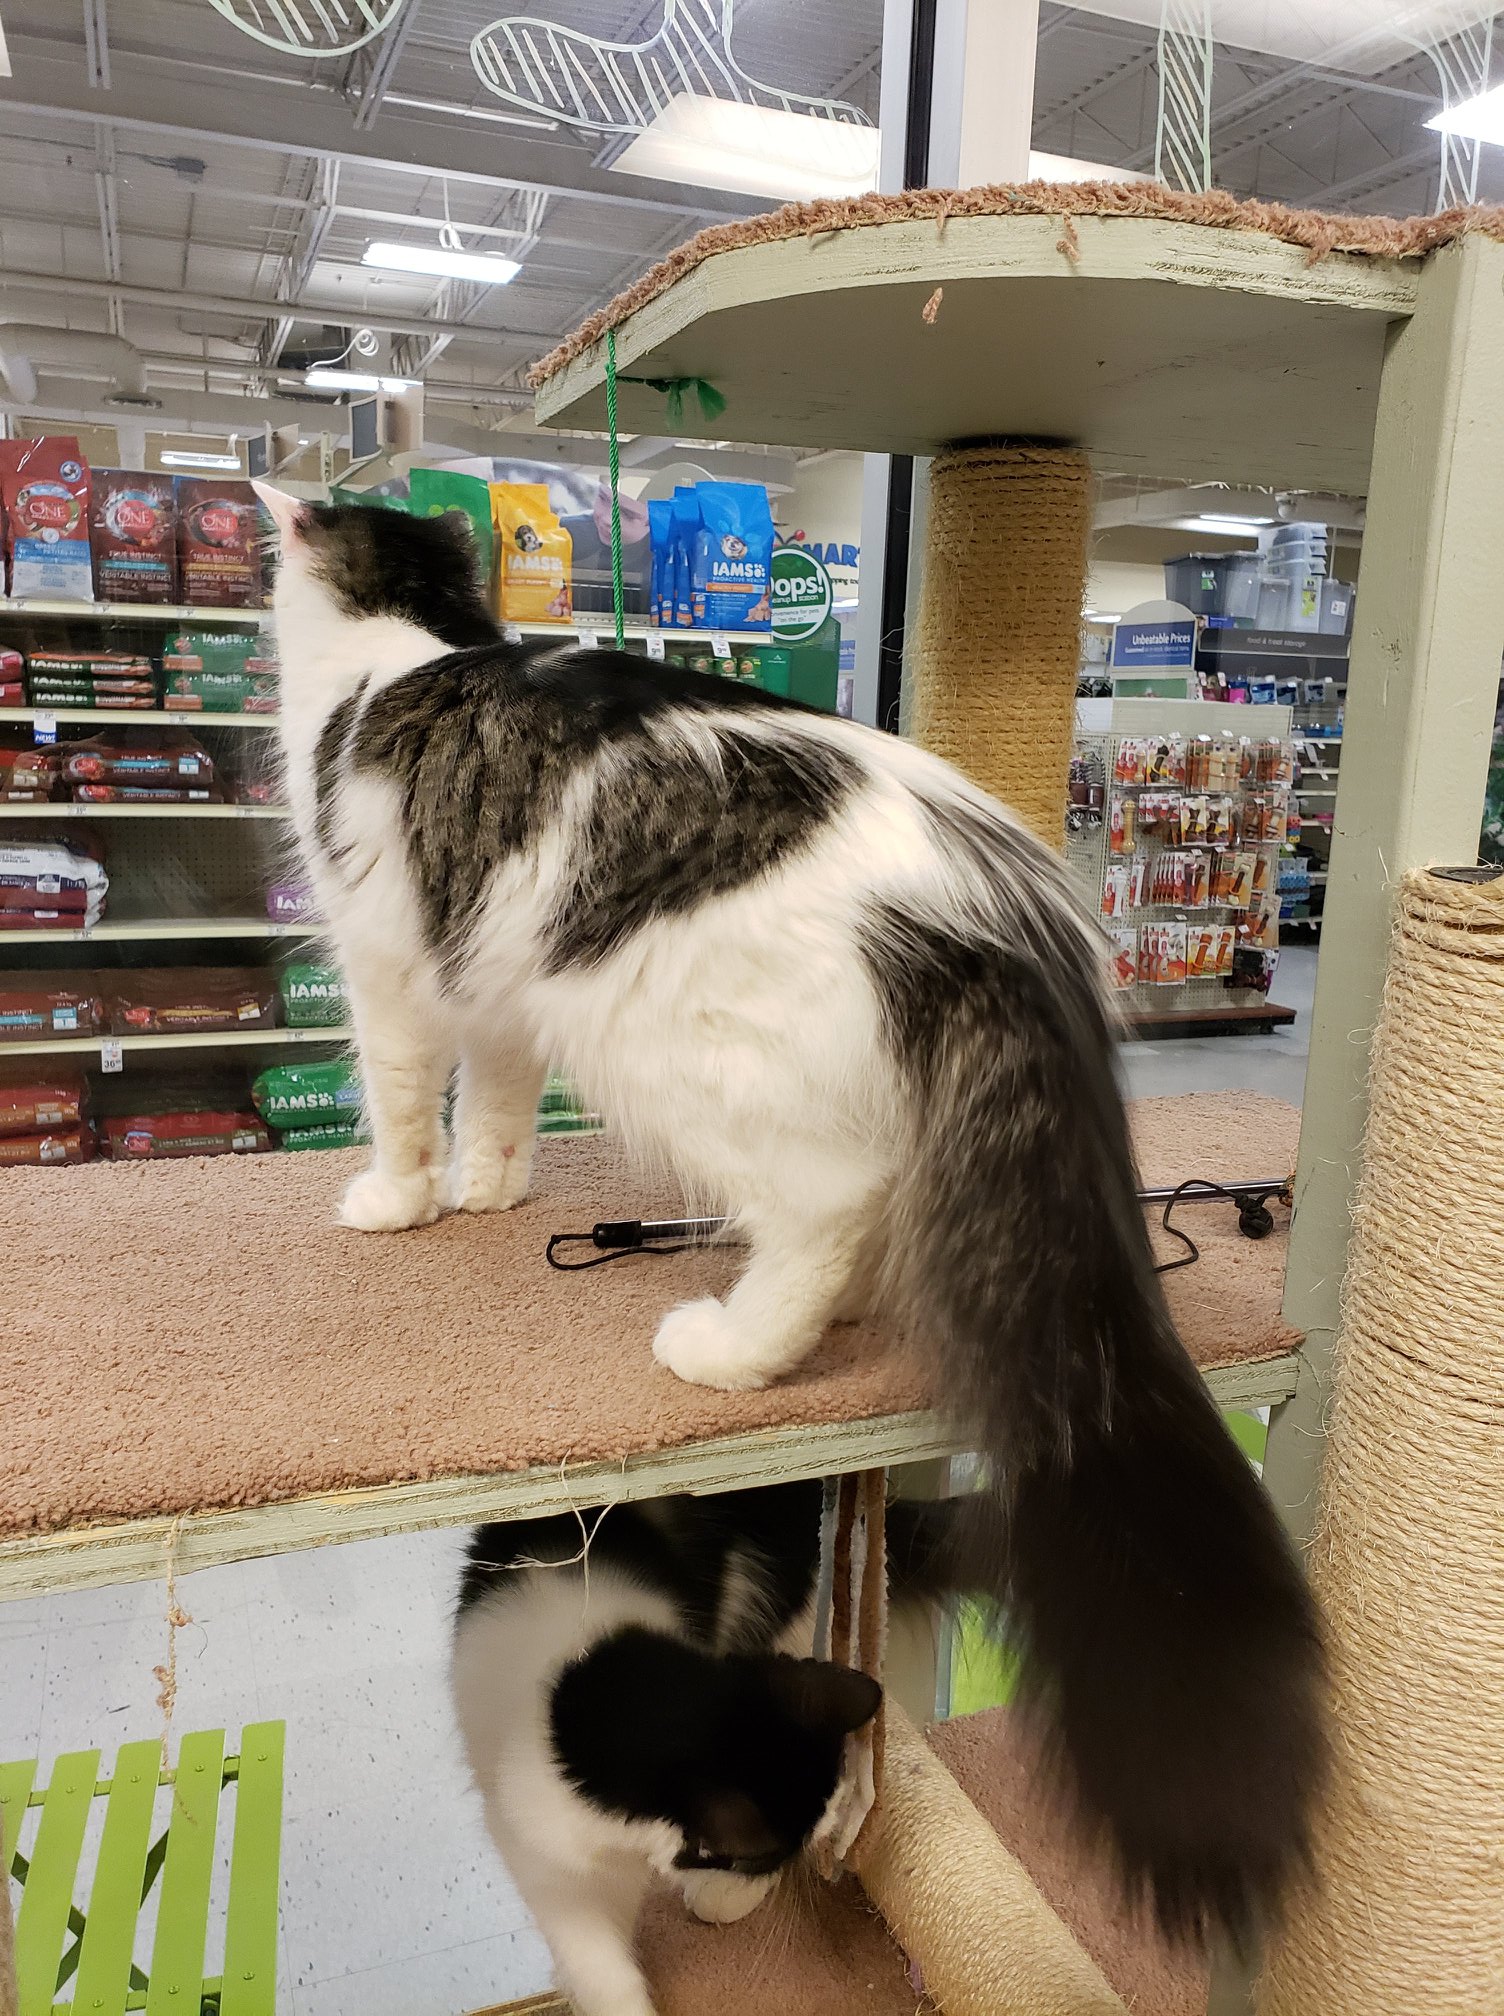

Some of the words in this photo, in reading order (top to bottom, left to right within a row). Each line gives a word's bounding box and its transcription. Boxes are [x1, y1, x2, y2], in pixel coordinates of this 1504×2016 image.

[117, 509, 150, 524] ONE
[202, 515, 232, 530] ONE
[507, 555, 550, 571] IAMS
[803, 543, 860, 568] MAR
[713, 561, 753, 578] IAMS
[770, 566, 824, 602] ops!
[1132, 632, 1170, 646] Unbeatable
[1170, 632, 1191, 644] Prices
[290, 984, 341, 999] IAMS
[270, 1094, 318, 1110] IAMS
